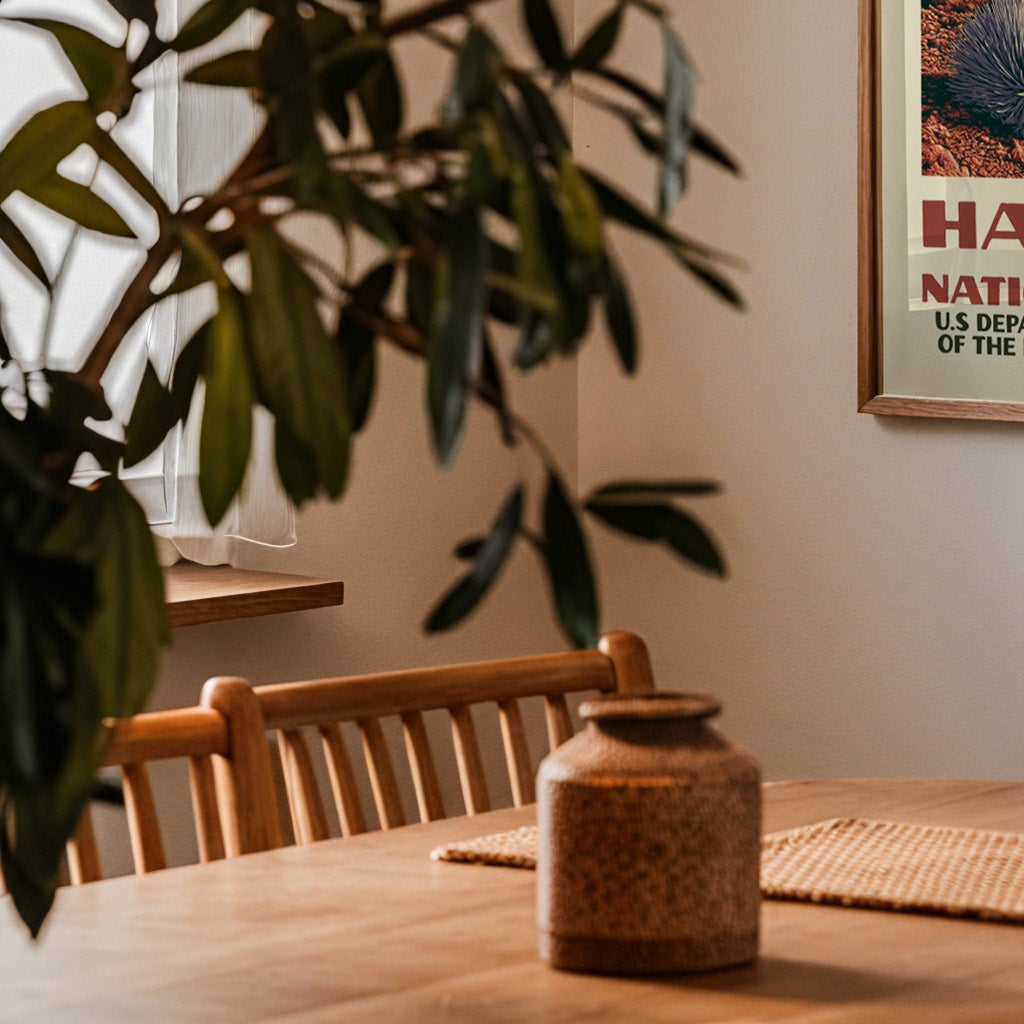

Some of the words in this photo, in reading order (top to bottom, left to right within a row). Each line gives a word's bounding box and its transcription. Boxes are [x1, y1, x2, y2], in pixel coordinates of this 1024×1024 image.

[935, 311, 970, 331] U.S
[937, 334, 966, 353] OF
[972, 335, 1016, 356] THE
